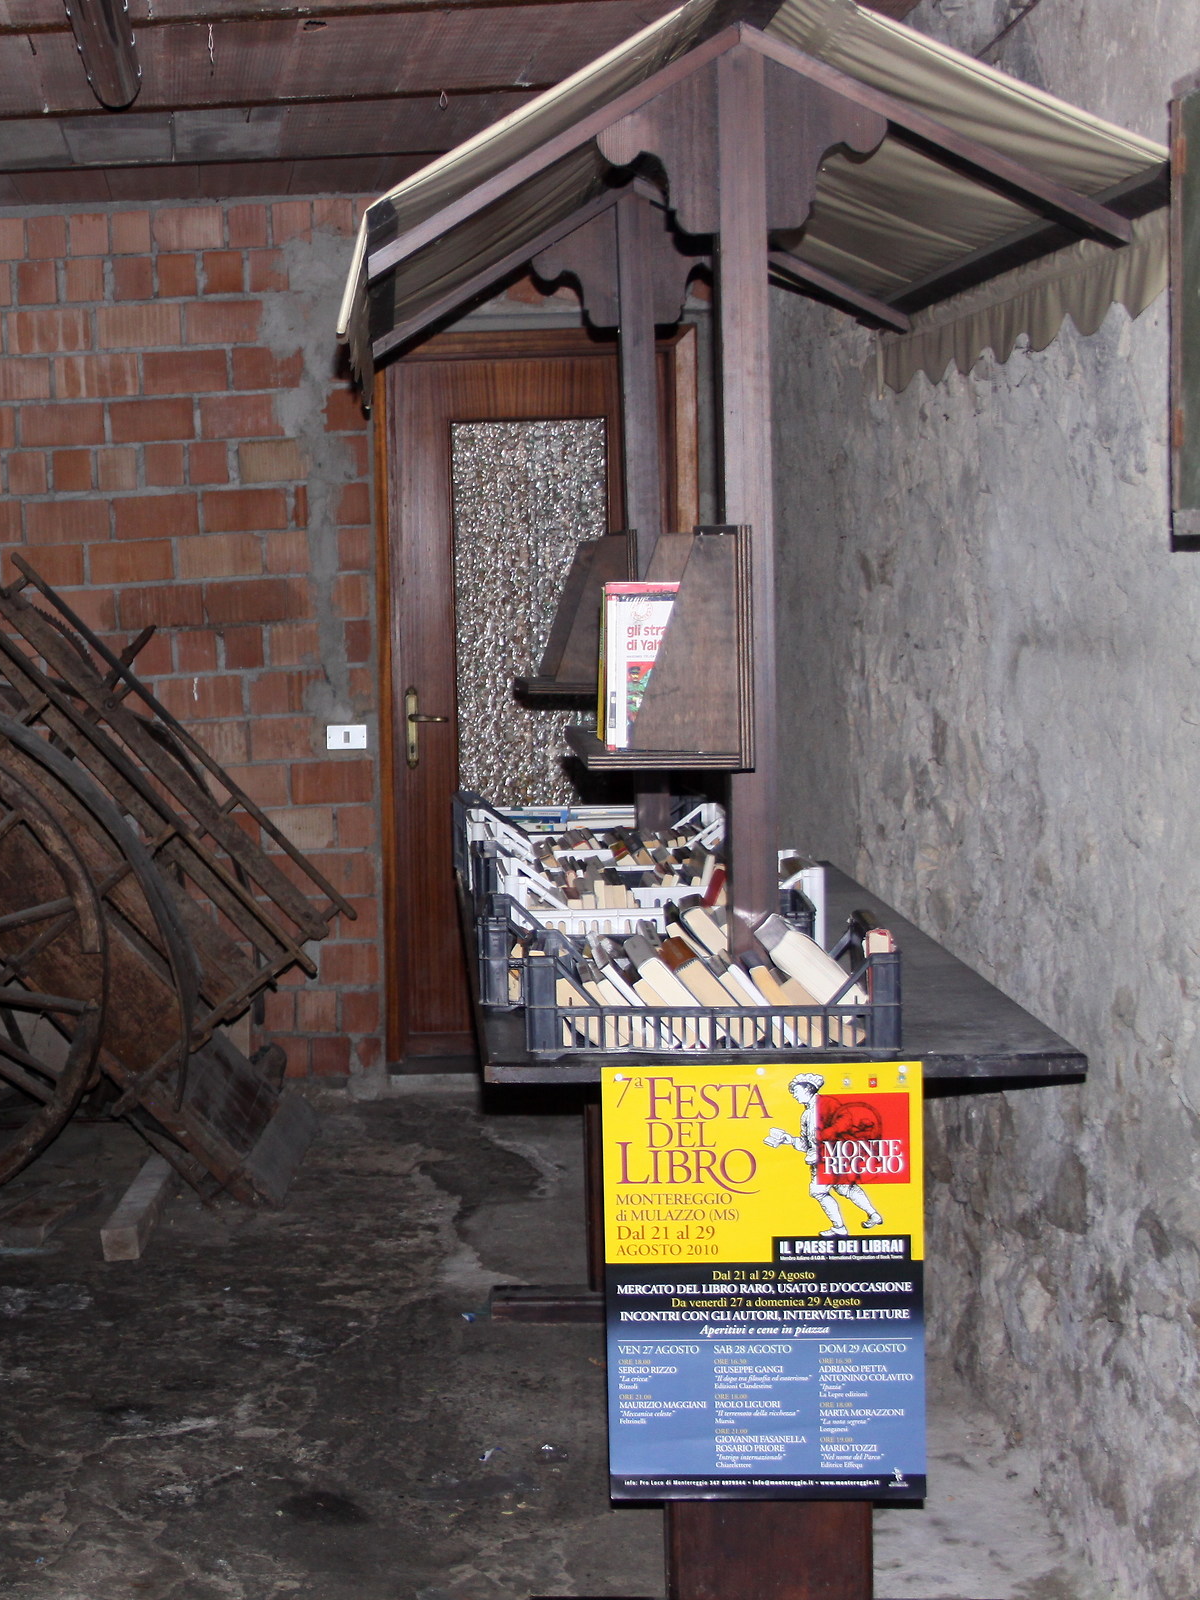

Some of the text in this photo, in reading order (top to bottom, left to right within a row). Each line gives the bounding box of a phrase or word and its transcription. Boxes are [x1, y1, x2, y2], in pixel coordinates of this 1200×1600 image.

[627, 624, 640, 638] gli
[626, 640, 637, 650] di
[644, 1076, 773, 1120] FESTA
[647, 1121, 716, 1148] DEL
[822, 1139, 902, 1157] MONTE
[616, 1141, 760, 1194] LIBRO
[822, 1155, 903, 1174] REGGIO
[616, 1192, 732, 1205] MONTEREGGIO
[615, 1208, 739, 1221] di MULAZZO (MS)
[617, 1224, 715, 1240] Dal 21 al 29
[616, 1243, 718, 1256] AGOSTO 2010
[779, 1239, 903, 1254] IL PAESE DEI LIBRAI
[712, 1269, 815, 1282] Dal 21 al 29 Agosto
[617, 1281, 912, 1295] MERCATO DEL LIBRO RARO, USATO E D'OCCASIONE
[671, 1296, 860, 1308] Da venerdì 27 a domenica 29 Agosto
[620, 1308, 909, 1321] INCONTRI CON GLI AUTORI, INTERVISTE, LETTURE
[699, 1324, 746, 1338] Aperitivi
[781, 1324, 792, 1334] in
[793, 1323, 829, 1337] piazza
[617, 1344, 699, 1355] VEN 27 AGOSTO
[713, 1344, 792, 1354] SAB 28 AGOSTO
[818, 1343, 906, 1353] DOM 29 AGOSTO
[618, 1366, 649, 1374] SERGIO
[713, 1365, 783, 1373] GIUSEPPE GANGI
[818, 1364, 887, 1373] ADRIANO PETTA
[818, 1373, 913, 1382] ANTONINO COLAVITO
[619, 1400, 706, 1409] MAURIZIO MAGGIANI
[714, 1400, 780, 1408] PAOLO LIGUORI
[819, 1408, 904, 1416] MARTA MORAZZONI
[714, 1435, 806, 1443] GIOVANNI FASANELLA
[715, 1444, 785, 1452] ROSARIO PRIORE
[819, 1443, 876, 1452] MARIO TOZZI
